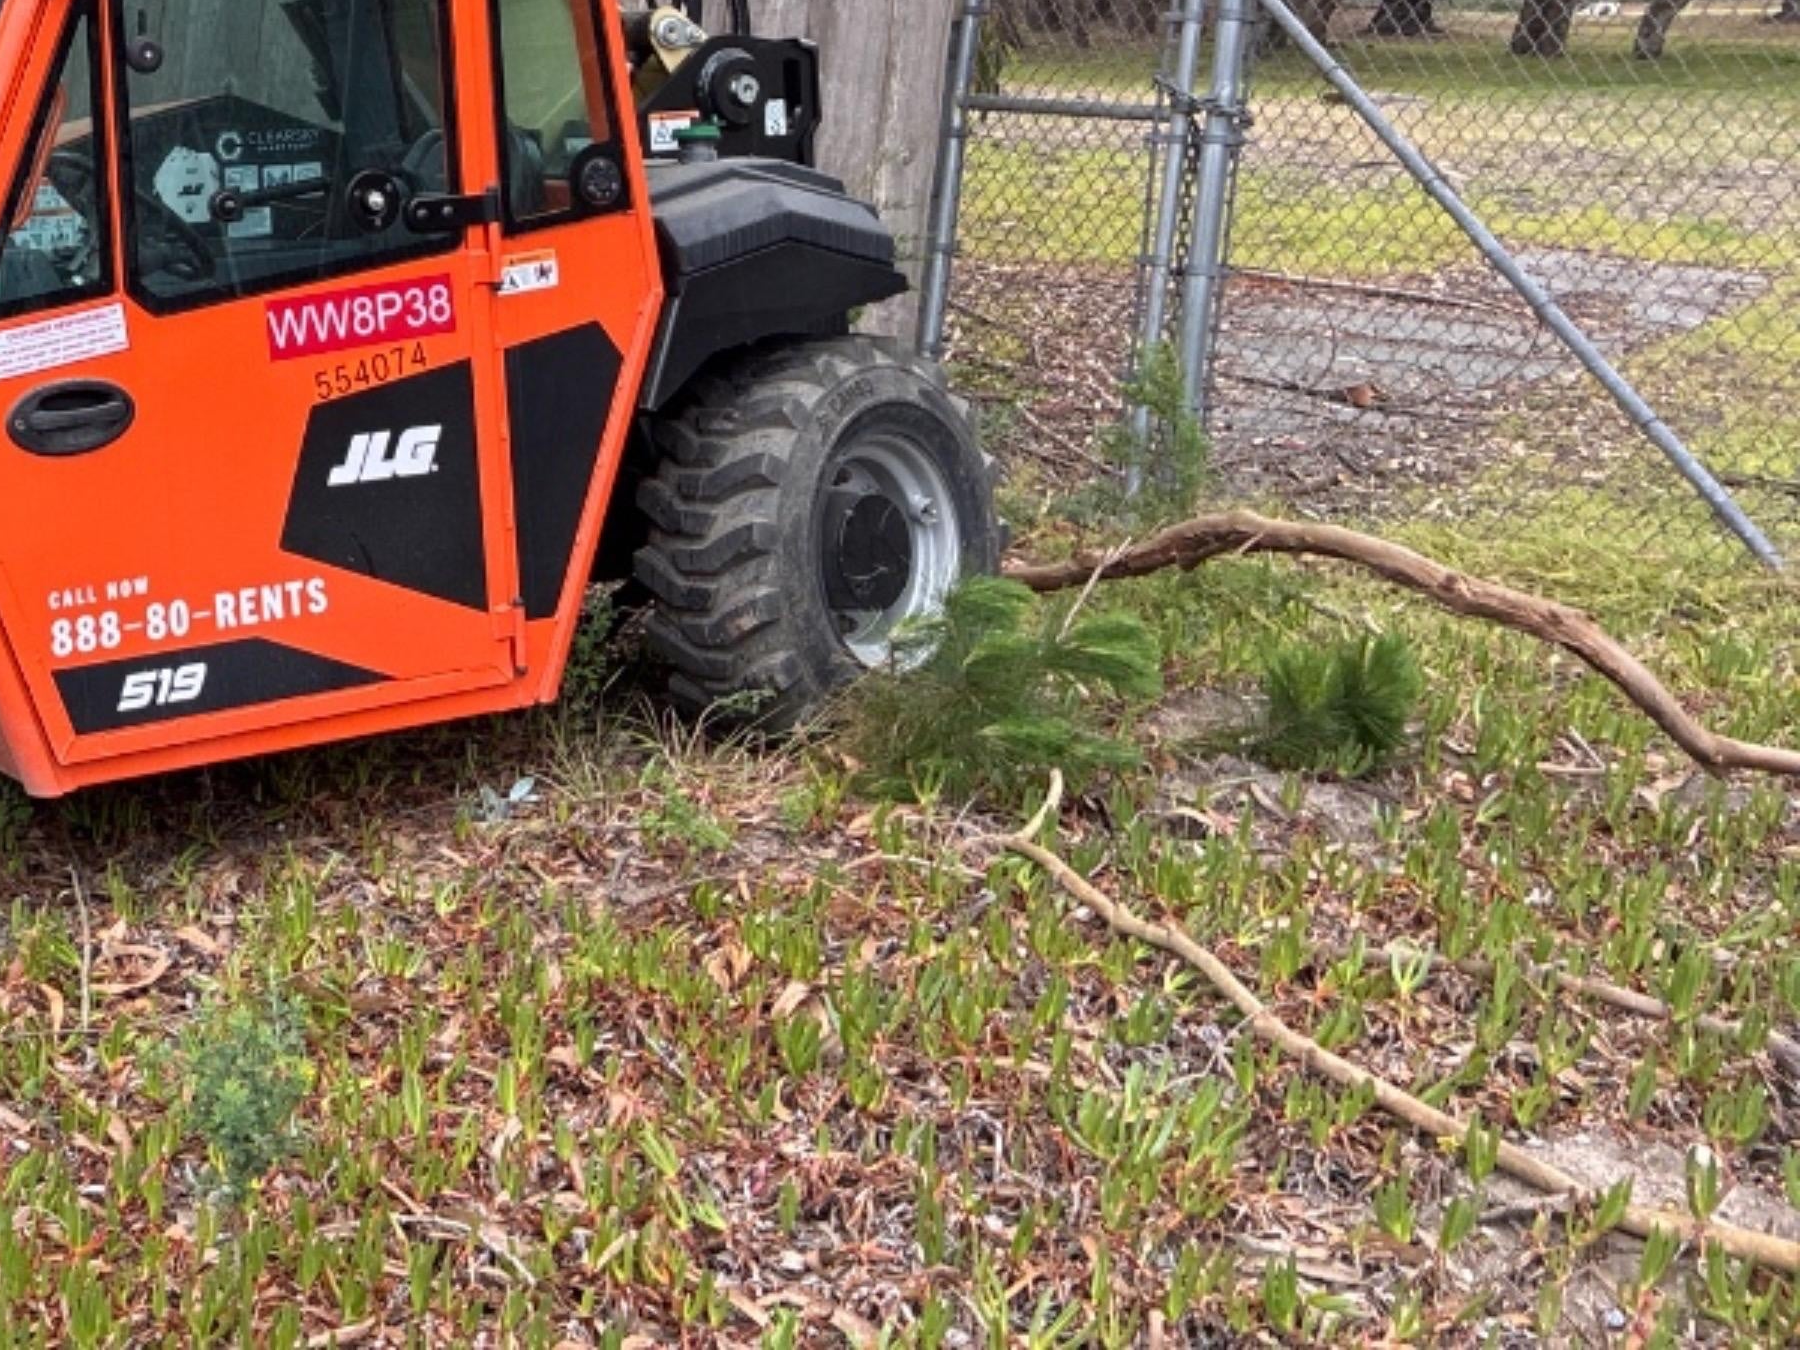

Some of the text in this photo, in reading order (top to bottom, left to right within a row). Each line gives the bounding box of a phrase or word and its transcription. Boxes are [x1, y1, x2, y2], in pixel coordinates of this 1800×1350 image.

[267, 284, 451, 349] WW8P38
[314, 341, 427, 399] 554074
[326, 423, 442, 486] JLG
[48, 576, 149, 610] CALL NOW
[51, 577, 328, 657] 888-80-RENTS
[116, 662, 208, 712] 519
